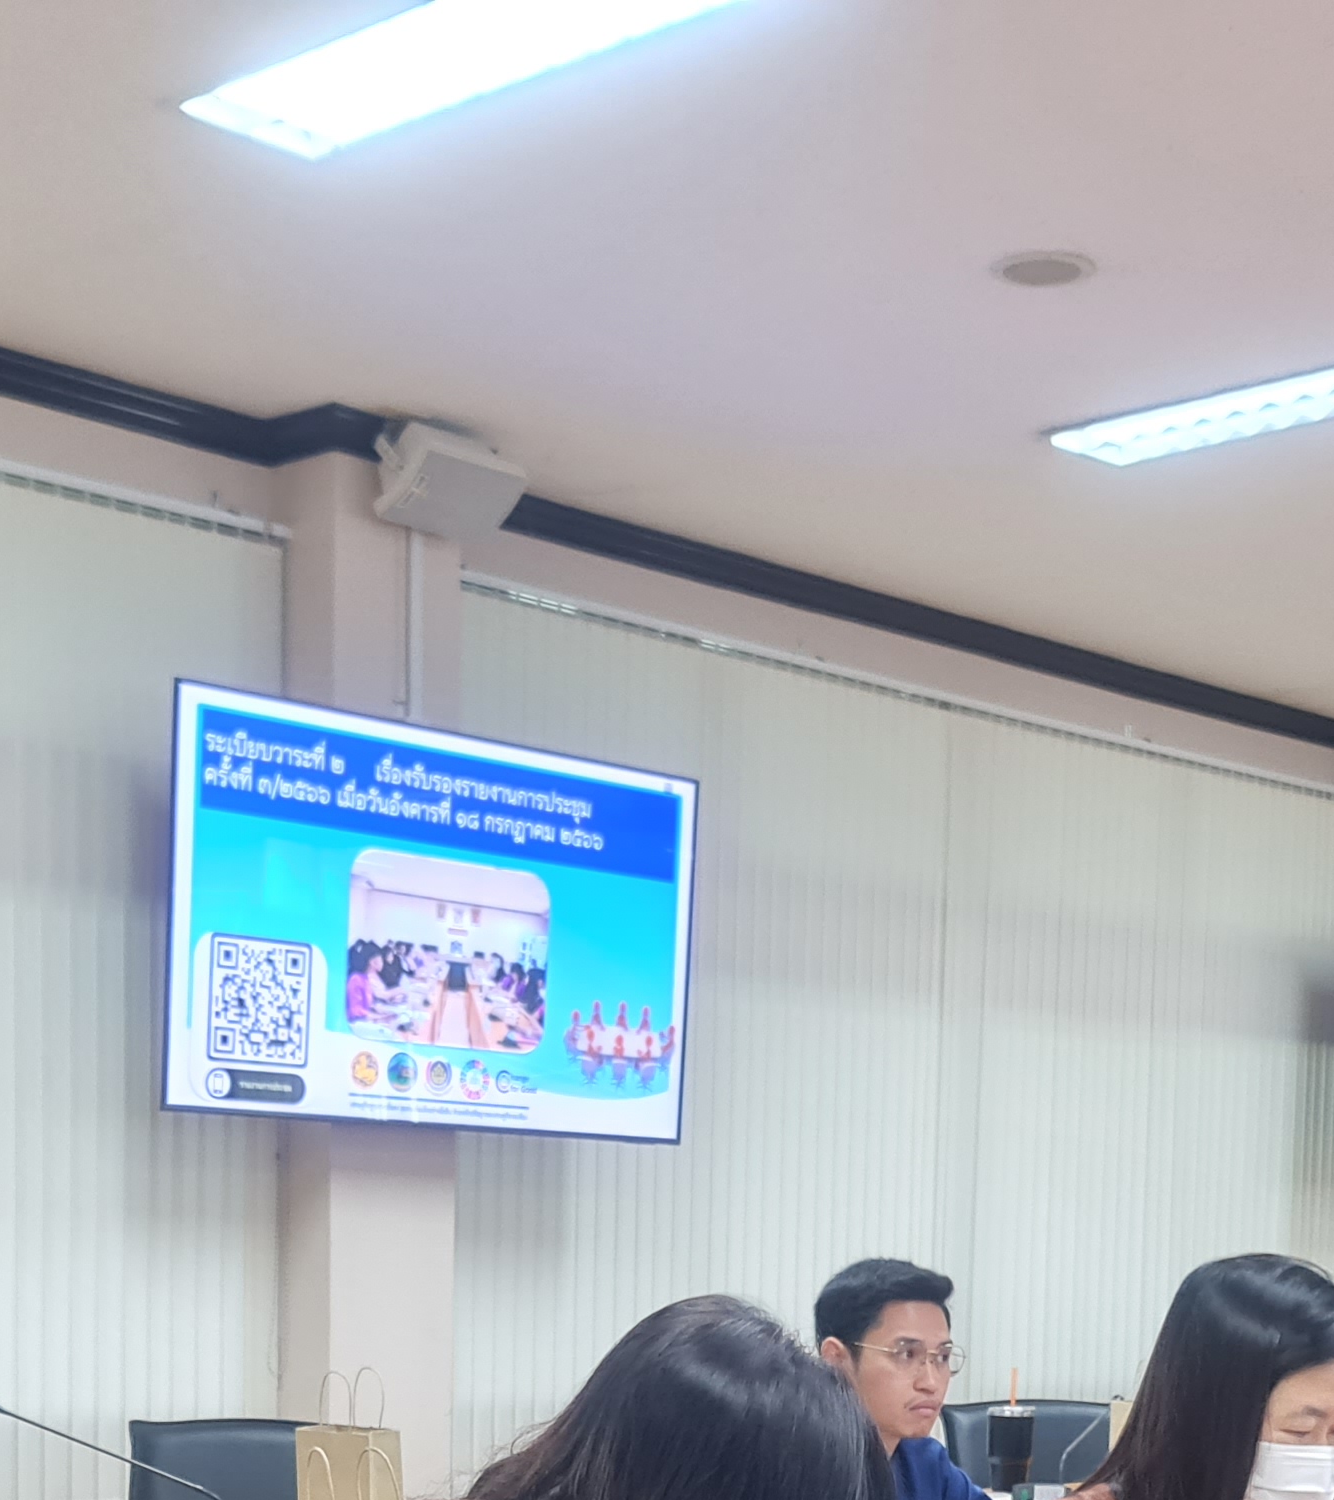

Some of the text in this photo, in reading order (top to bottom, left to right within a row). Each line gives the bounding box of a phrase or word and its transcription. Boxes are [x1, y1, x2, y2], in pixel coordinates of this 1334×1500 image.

[204, 754, 253, 792] ครั้งที่
[484, 813, 556, 844] กรกฎาคม
[205, 730, 593, 824] ระเบียบวาระที่ ๒ เรื่องรับรองรายงานการประชุม
